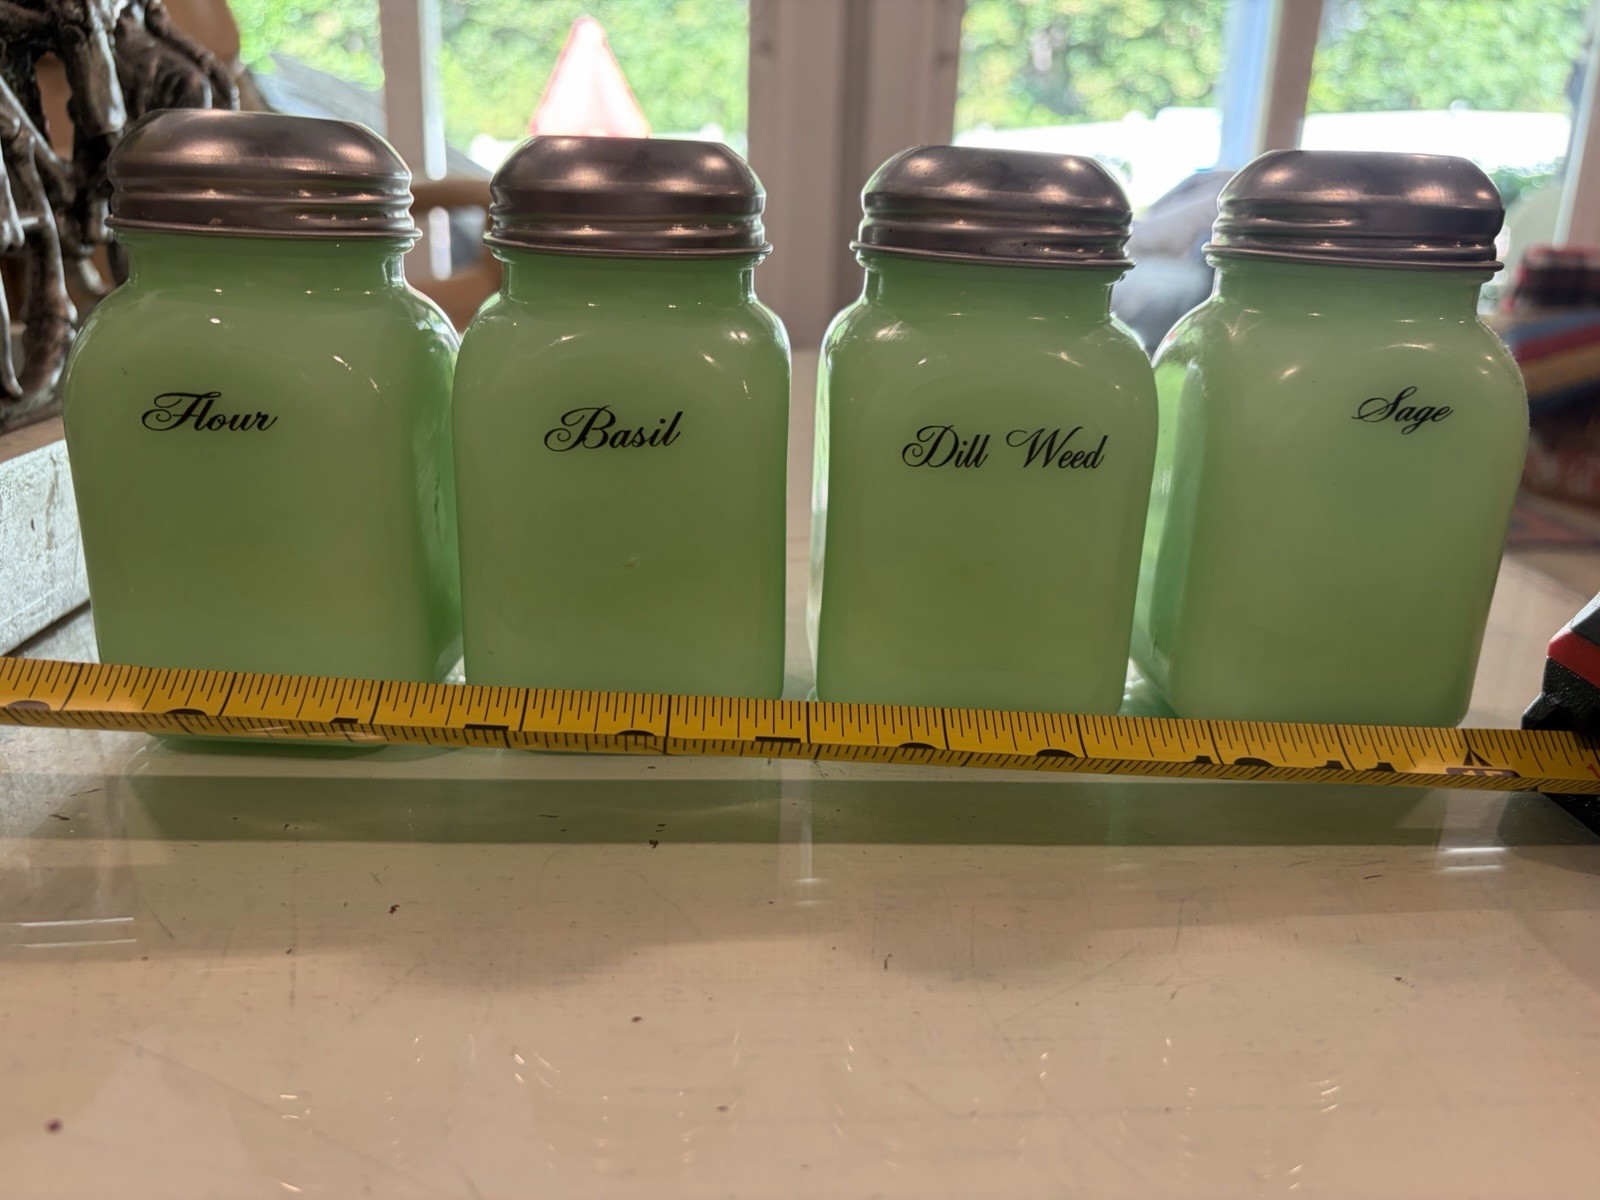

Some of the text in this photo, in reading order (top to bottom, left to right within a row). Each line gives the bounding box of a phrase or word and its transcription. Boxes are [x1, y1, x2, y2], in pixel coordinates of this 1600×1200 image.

[142, 391, 278, 432] Flour
[544, 406, 683, 452] Basil
[1352, 387, 1453, 435] Sage
[902, 425, 1108, 469] Dill Weed
